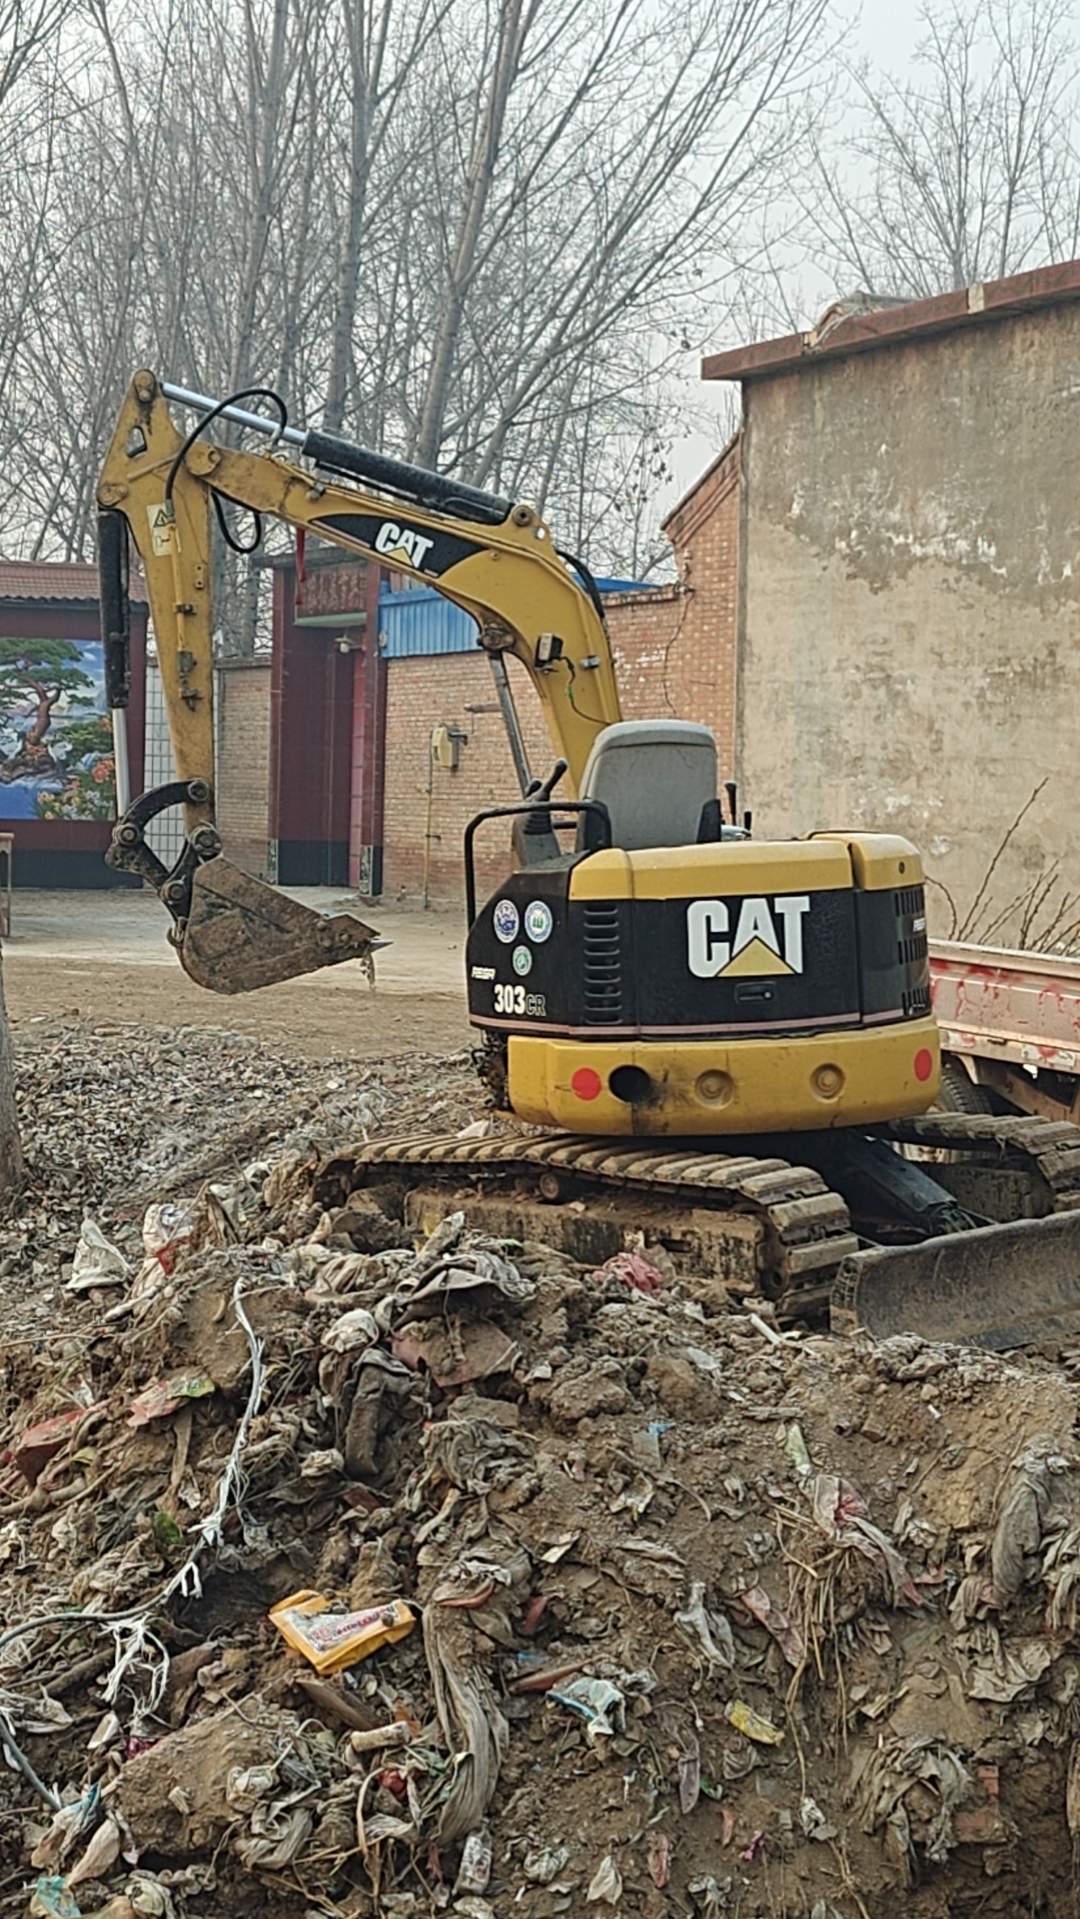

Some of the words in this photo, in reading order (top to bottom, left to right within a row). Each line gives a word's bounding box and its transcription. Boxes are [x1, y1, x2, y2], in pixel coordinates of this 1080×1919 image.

[375, 522, 434, 568] CAT
[686, 895, 810, 978] CAT
[494, 984, 525, 1014] 303
[526, 993, 547, 1017] CR
